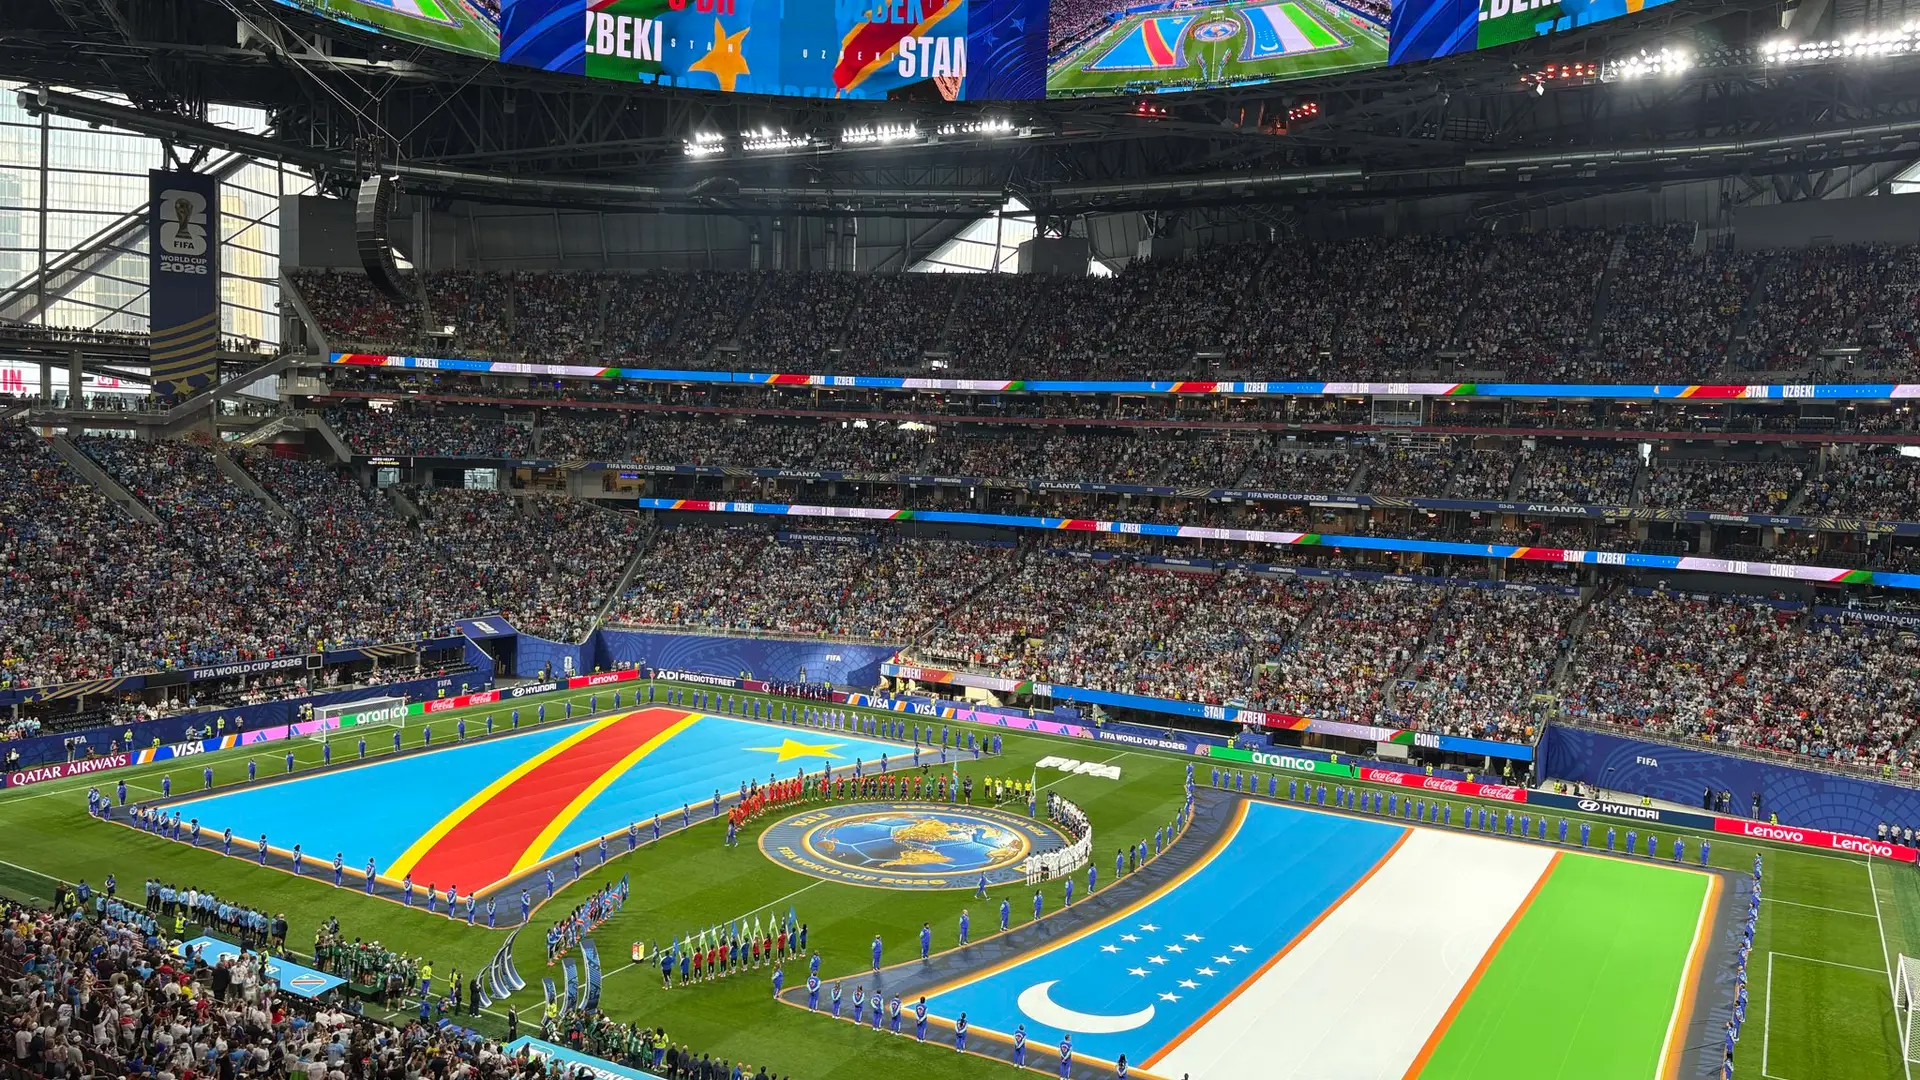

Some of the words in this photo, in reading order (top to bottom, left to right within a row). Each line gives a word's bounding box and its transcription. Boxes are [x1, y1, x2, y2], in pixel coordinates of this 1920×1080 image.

[173, 240, 195, 250] FIFA
[160, 254, 190, 264] WORLD
[190, 257, 207, 265] CUP
[160, 261, 208, 275] 2026
[1216, 382, 1234, 393] STAN
[1244, 382, 1268, 393] UZBEKI
[1745, 385, 1768, 398] STAN
[1782, 385, 1815, 398] UZBEKI
[778, 470, 821, 478] ATLANTA
[1039, 482, 1081, 490] ATLANTA
[1262, 492, 1288, 500] WORLD
[1288, 493, 1303, 501] CUP
[1303, 494, 1328, 502] 2026
[1527, 504, 1587, 514] ATLANTA
[1563, 549, 1584, 563] STAN
[1596, 551, 1626, 565] UZBEKI
[1727, 560, 1734, 573] O
[1735, 561, 1748, 574] DR
[1770, 563, 1794, 577] CONG
[825, 654, 842, 662] FIFA
[193, 669, 217, 679] FIFA
[216, 662, 251, 676] WORLD
[251, 661, 271, 672] CUP
[271, 658, 303, 669] 2026
[588, 675, 619, 685] Lenovo
[657, 670, 679, 681] ADI
[680, 673, 736, 688] PREDICTSTREET
[525, 683, 557, 695] HYUNDAI
[1032, 684, 1052, 696] CONG
[866, 697, 889, 709] VISA
[913, 704, 937, 716] VISA
[356, 706, 408, 723] aramco
[1204, 705, 1225, 719] STAN
[1237, 710, 1266, 725] UZBEKI
[1100, 731, 1115, 740] FIFA
[1115, 734, 1143, 744] WORLD
[1143, 738, 1158, 746] CUP
[1370, 727, 1376, 740] O
[1414, 733, 1440, 748] CONG
[169, 740, 205, 758] VISA
[1035, 755, 1121, 780] FIFA
[1251, 752, 1315, 771] aramco
[1636, 756, 1658, 767] FIFA
[12, 766, 62, 786] QATAR
[67, 754, 126, 776] AIRWAYS
[1602, 803, 1660, 820] HYUNDAI
[1744, 822, 1804, 842] Lenovo
[1832, 835, 1892, 856] Lenovo
[777, 846, 799, 859] FIFA
[798, 857, 843, 875] WORLD
[842, 872, 878, 881] CUP
